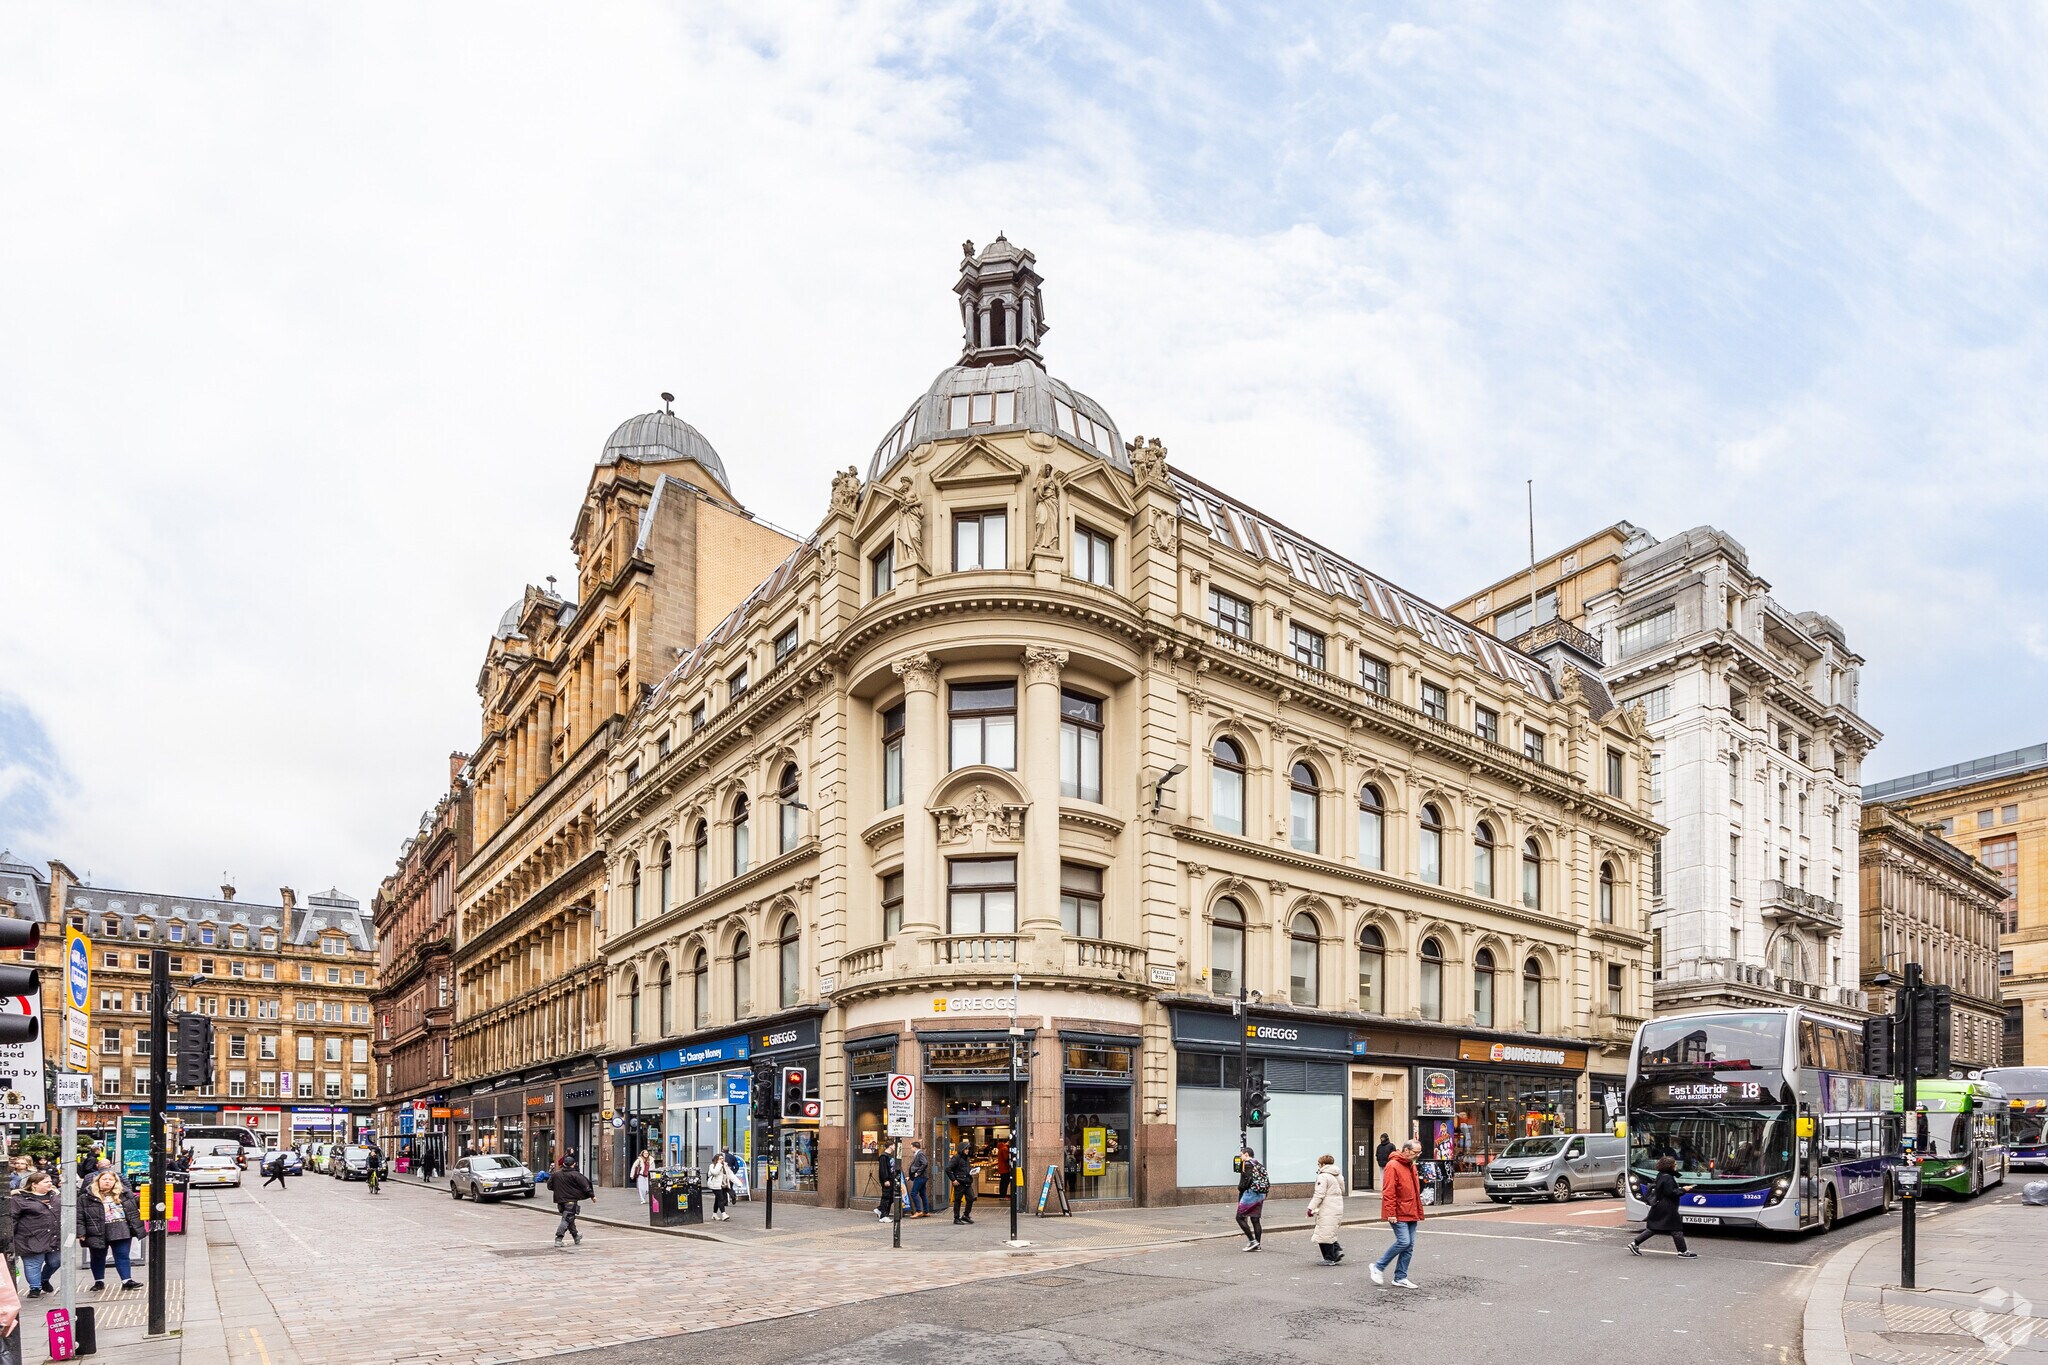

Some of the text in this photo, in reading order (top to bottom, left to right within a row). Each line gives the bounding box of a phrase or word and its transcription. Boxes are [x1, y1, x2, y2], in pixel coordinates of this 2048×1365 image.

[949, 996, 1016, 1011] GREGGS
[769, 1030, 797, 1045] GREGGS
[1257, 1026, 1298, 1041] GREGGS
[687, 1053, 704, 1062] Change
[704, 1049, 722, 1059] Money
[1504, 1046, 1565, 1065] BURGER KING
[24, 1069, 38, 1077] by
[620, 1060, 643, 1073] NEWS 24
[59, 1079, 79, 1088] Bus lane
[1668, 1082, 1759, 1098] East Kilbride 18
[1938, 1099, 1947, 1109] 7
[50, 1321, 69, 1329] CHEWING
